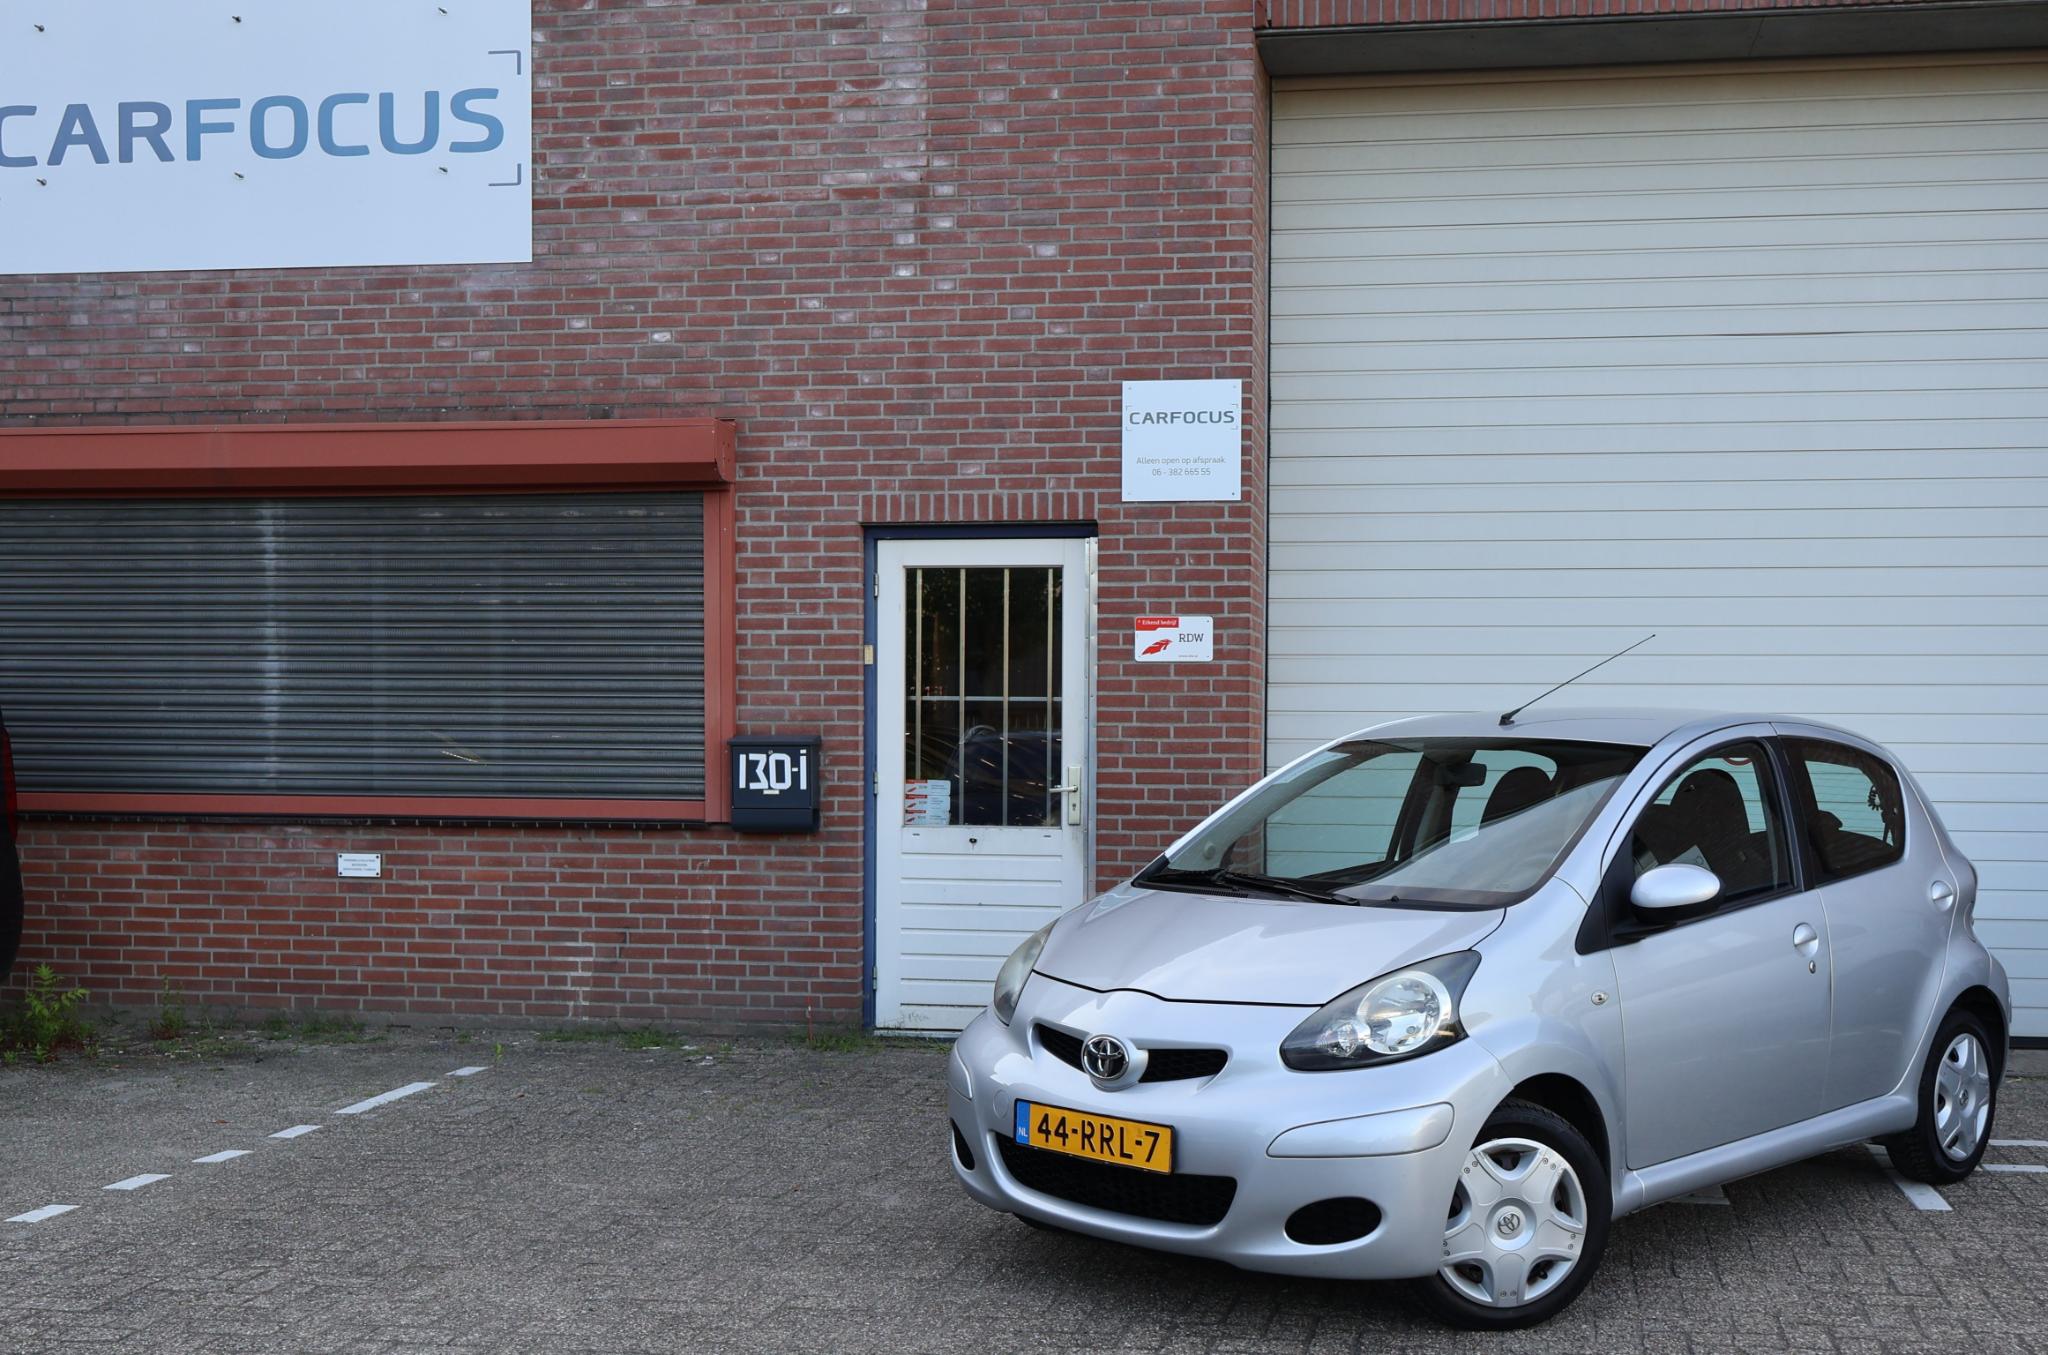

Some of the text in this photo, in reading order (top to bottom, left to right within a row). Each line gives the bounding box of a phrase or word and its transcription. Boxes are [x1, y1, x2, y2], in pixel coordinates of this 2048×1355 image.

[0, 88, 505, 168] CARFOCUS
[1129, 410, 1235, 425] CARFOCUS
[1136, 456, 1160, 465] Alleen
[1161, 458, 1180, 466] open
[1181, 458, 1191, 466] op
[1152, 468, 1162, 477] 06
[1168, 467, 1183, 477] 382
[1179, 633, 1204, 643] RDW
[1018, 1113, 1160, 1163] NL 44-RRL-7
